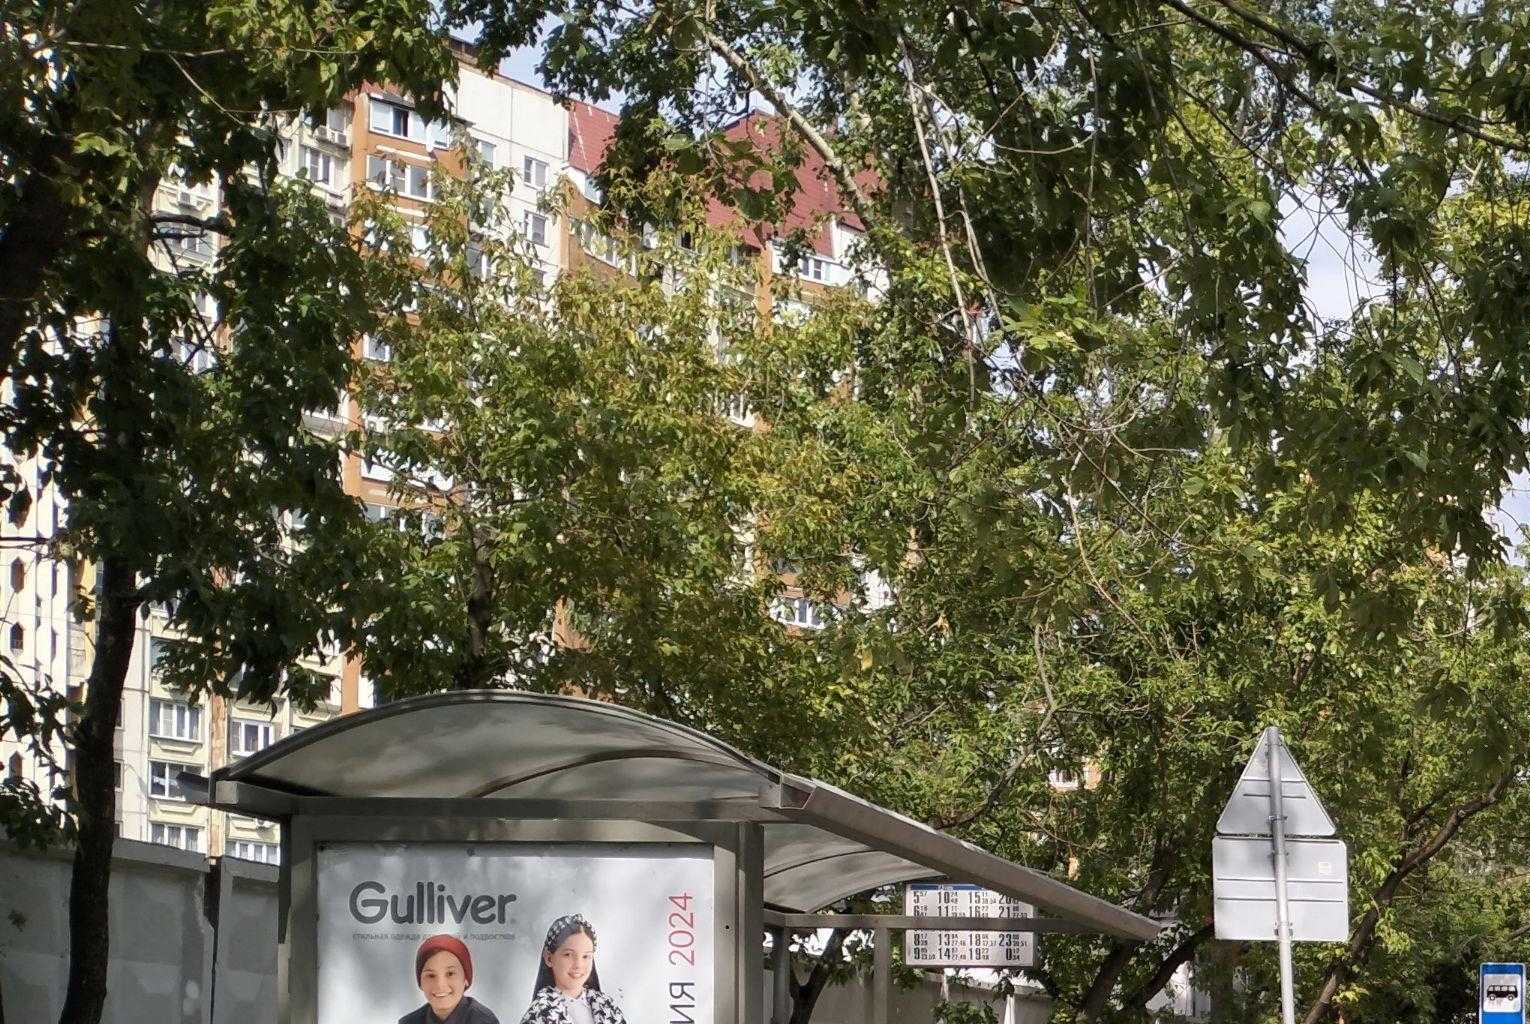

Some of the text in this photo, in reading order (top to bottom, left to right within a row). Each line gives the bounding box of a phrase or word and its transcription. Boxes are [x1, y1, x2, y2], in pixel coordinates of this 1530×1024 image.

[349, 881, 517, 924] Gulliver
[668, 892, 695, 967] 2024
[999, 934, 1012, 946] 23
